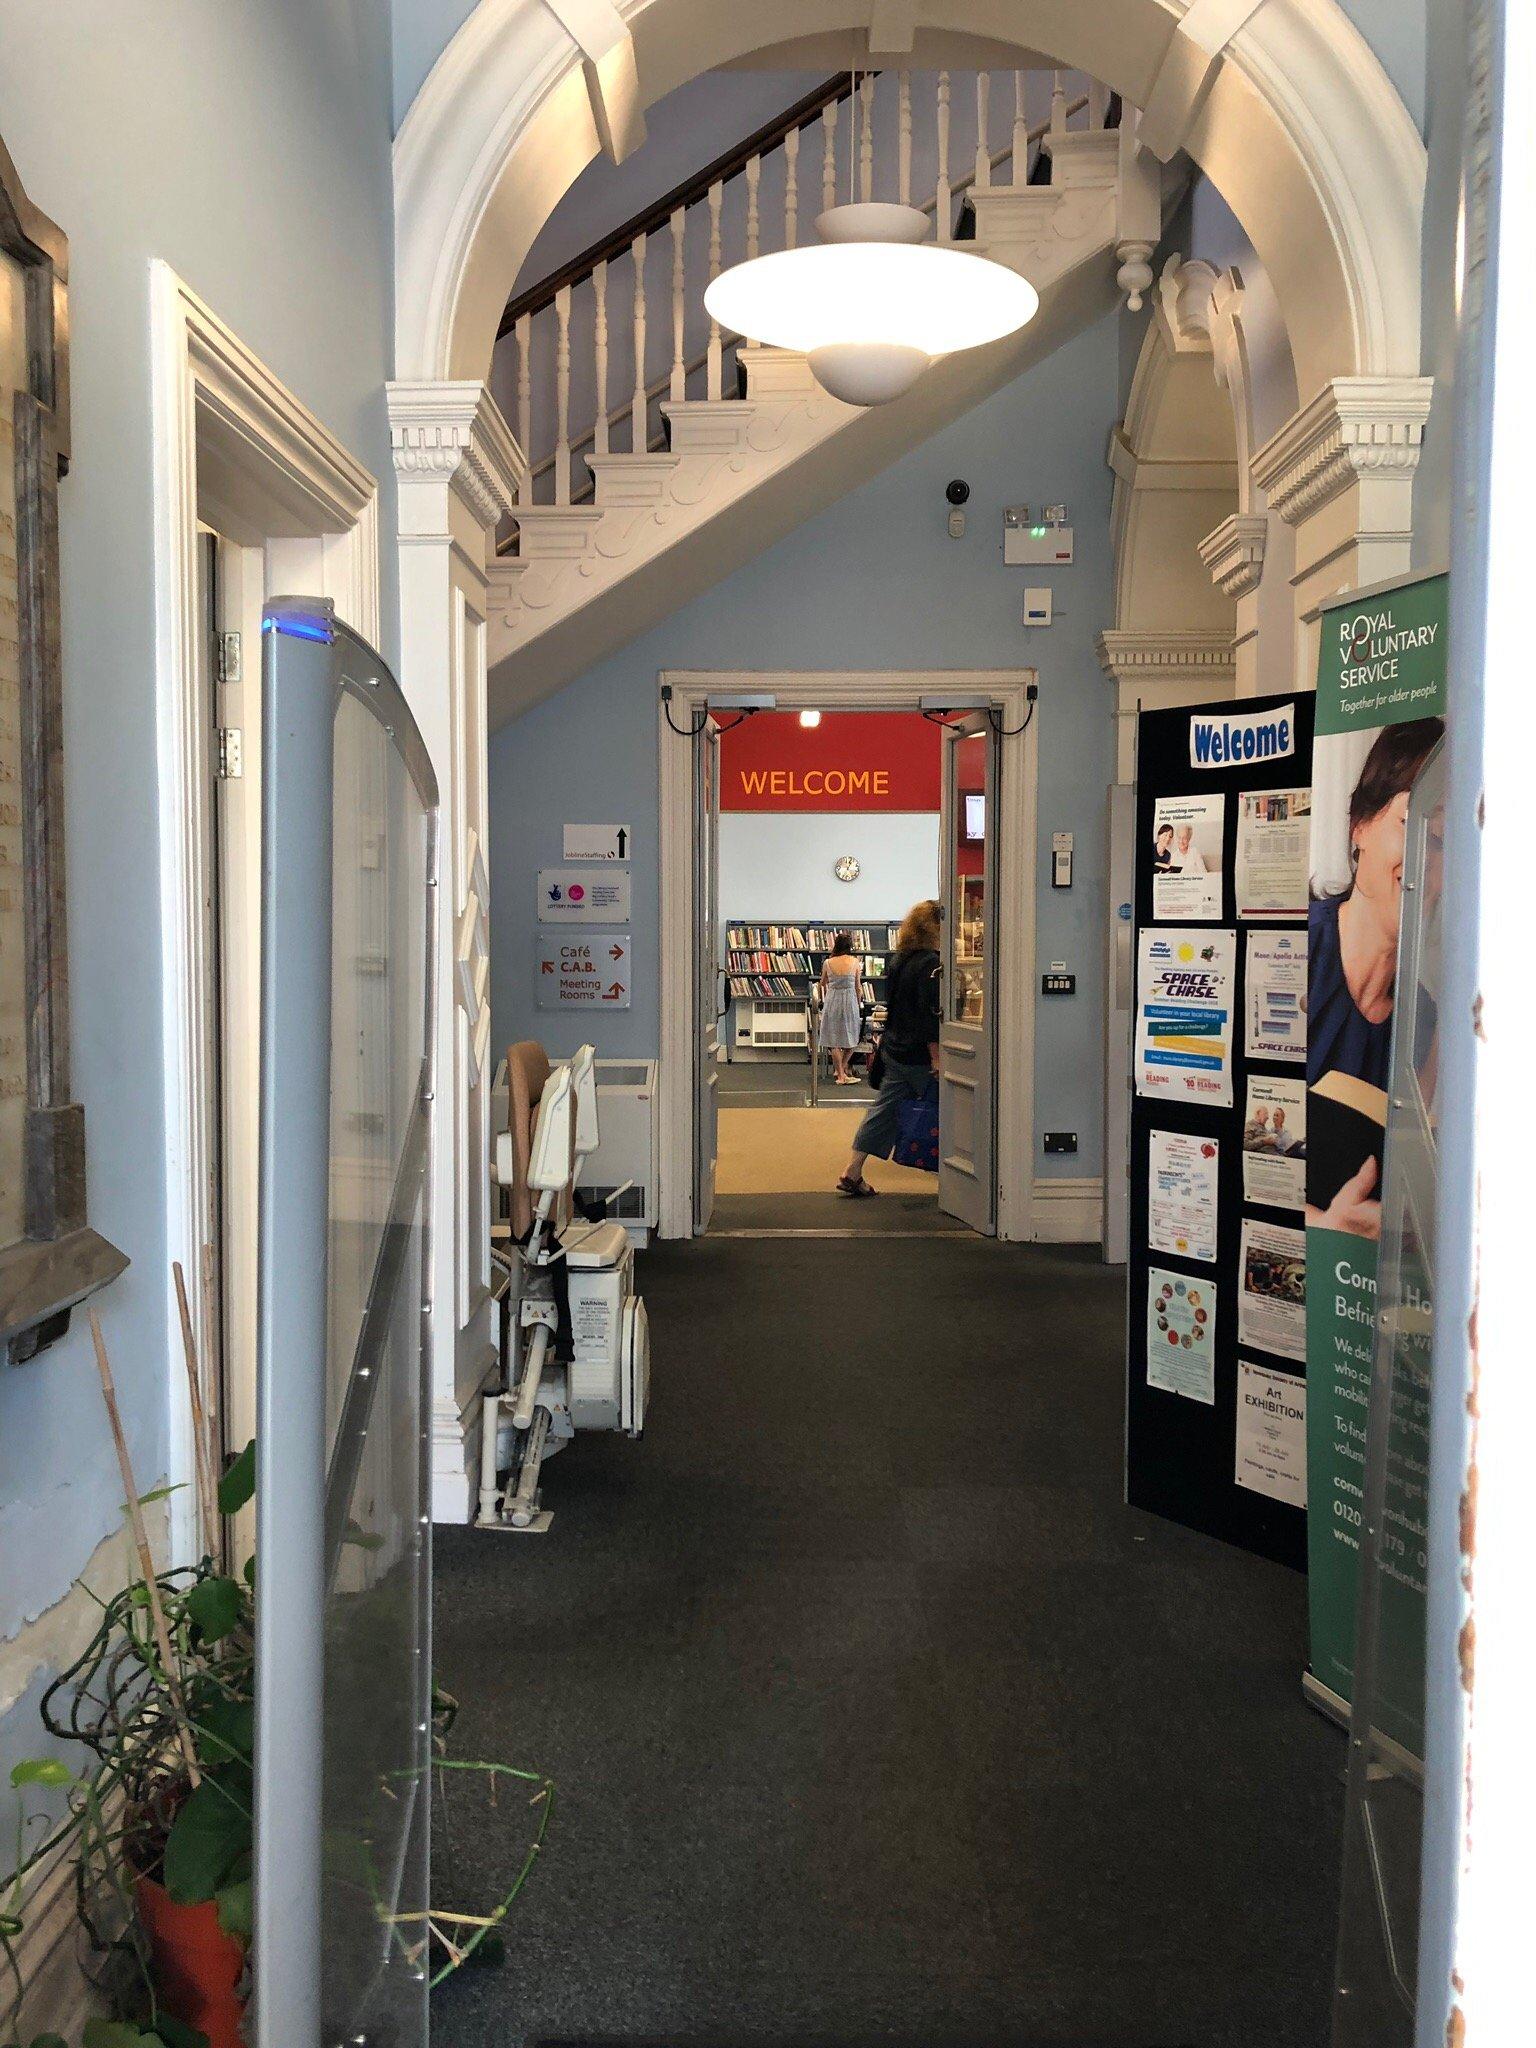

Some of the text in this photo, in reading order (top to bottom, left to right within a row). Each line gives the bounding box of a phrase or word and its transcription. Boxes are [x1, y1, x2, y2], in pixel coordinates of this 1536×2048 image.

[1340, 611, 1396, 645] ROYAL
[1340, 623, 1438, 665] VOLUNTARY
[1340, 658, 1399, 689] SERVICE
[1340, 681, 1438, 714] Together for older people
[1194, 719, 1290, 763] Welcome
[740, 770, 889, 795] WELCOME
[560, 945, 591, 958] Café
[560, 961, 597, 973] C.A.B.
[560, 980, 601, 991] Meeting
[1153, 972, 1211, 986] SPACE
[560, 990, 596, 1000] Rooms
[1166, 984, 1219, 999] CHASE
[1204, 1011, 1220, 1020] library
[1254, 1042, 1283, 1052] SPACE
[1334, 1336, 1353, 1355] We
[1334, 1361, 1358, 1379] who
[1266, 1387, 1282, 1400] Art
[1245, 1394, 1304, 1421] EXHIBITION
[1334, 1415, 1348, 1433] To
[1349, 1421, 1367, 1443] find
[1333, 1500, 1362, 1527] 0120
